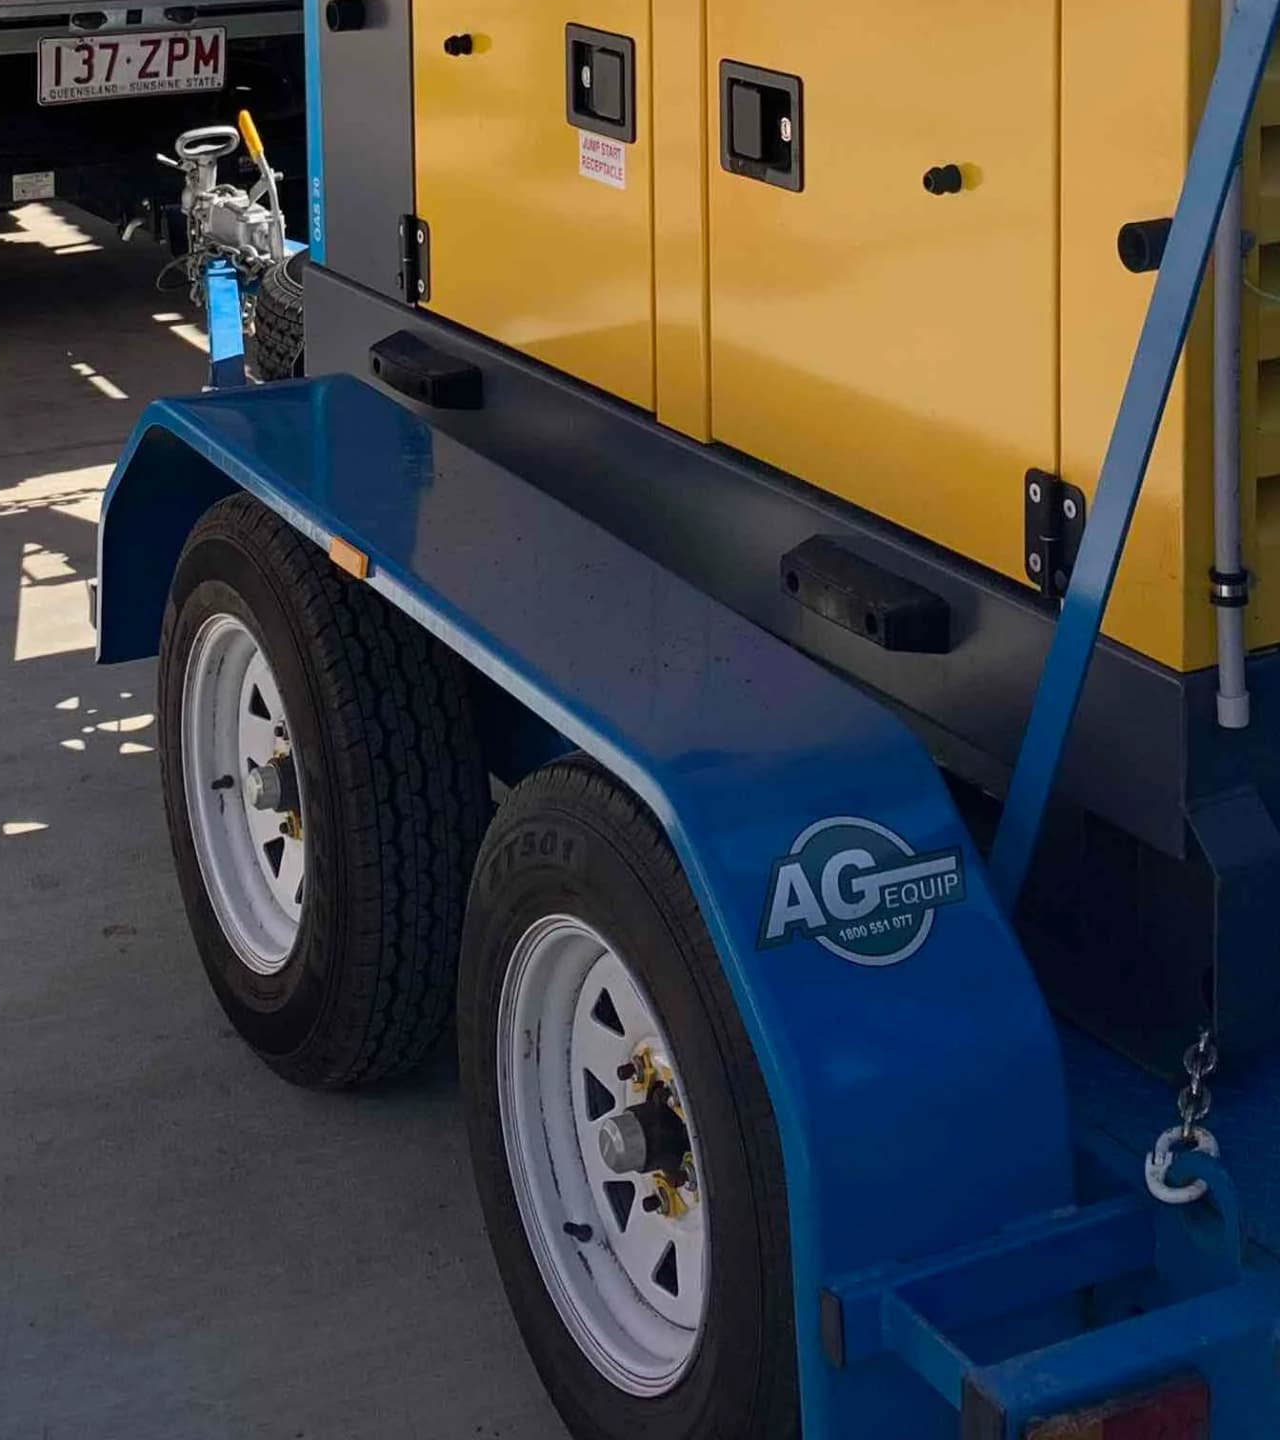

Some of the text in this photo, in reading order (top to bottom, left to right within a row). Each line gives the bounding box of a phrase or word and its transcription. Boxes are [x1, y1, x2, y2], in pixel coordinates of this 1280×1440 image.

[49, 78, 217, 100] QUEENSLAND SUNSHINE STATE
[766, 848, 957, 940] AG
[883, 873, 960, 910] EQUIP
[839, 914, 914, 943] 1800 551 077
